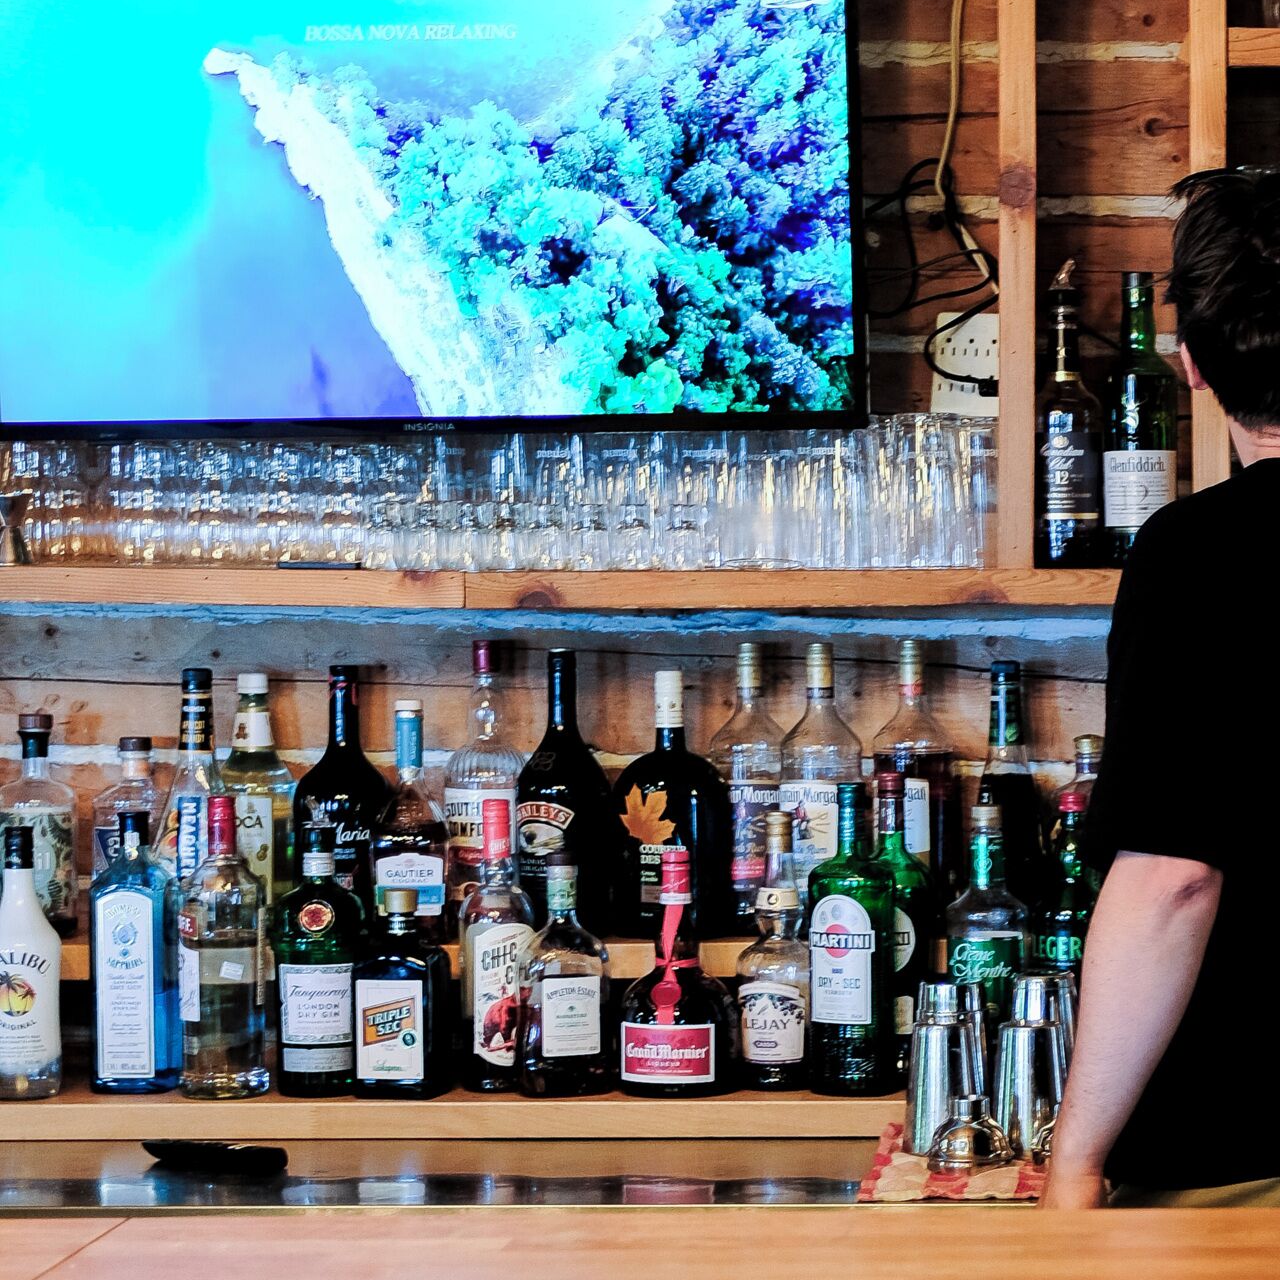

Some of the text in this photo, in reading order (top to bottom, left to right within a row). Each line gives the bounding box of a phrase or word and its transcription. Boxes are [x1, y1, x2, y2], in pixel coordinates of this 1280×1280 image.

[305, 23, 517, 41] BOSSA NOVA RELAXING
[403, 423, 456, 431] INSIGNIA
[1109, 457, 1167, 473] Glenfiddich
[1055, 470, 1070, 485] 12
[386, 869, 434, 878] GAUTIER
[812, 932, 870, 948] MARTINI
[0, 952, 52, 975] ALIBU
[481, 942, 517, 972] CHIC
[818, 977, 833, 988] DRY
[843, 978, 861, 989] SEC
[289, 984, 350, 1000] Tanqueray
[367, 1006, 410, 1026] TRIPLE
[744, 1018, 790, 1030] LEJAY
[376, 1021, 401, 1036] SEC
[626, 1042, 708, 1059] Grand Marnier
